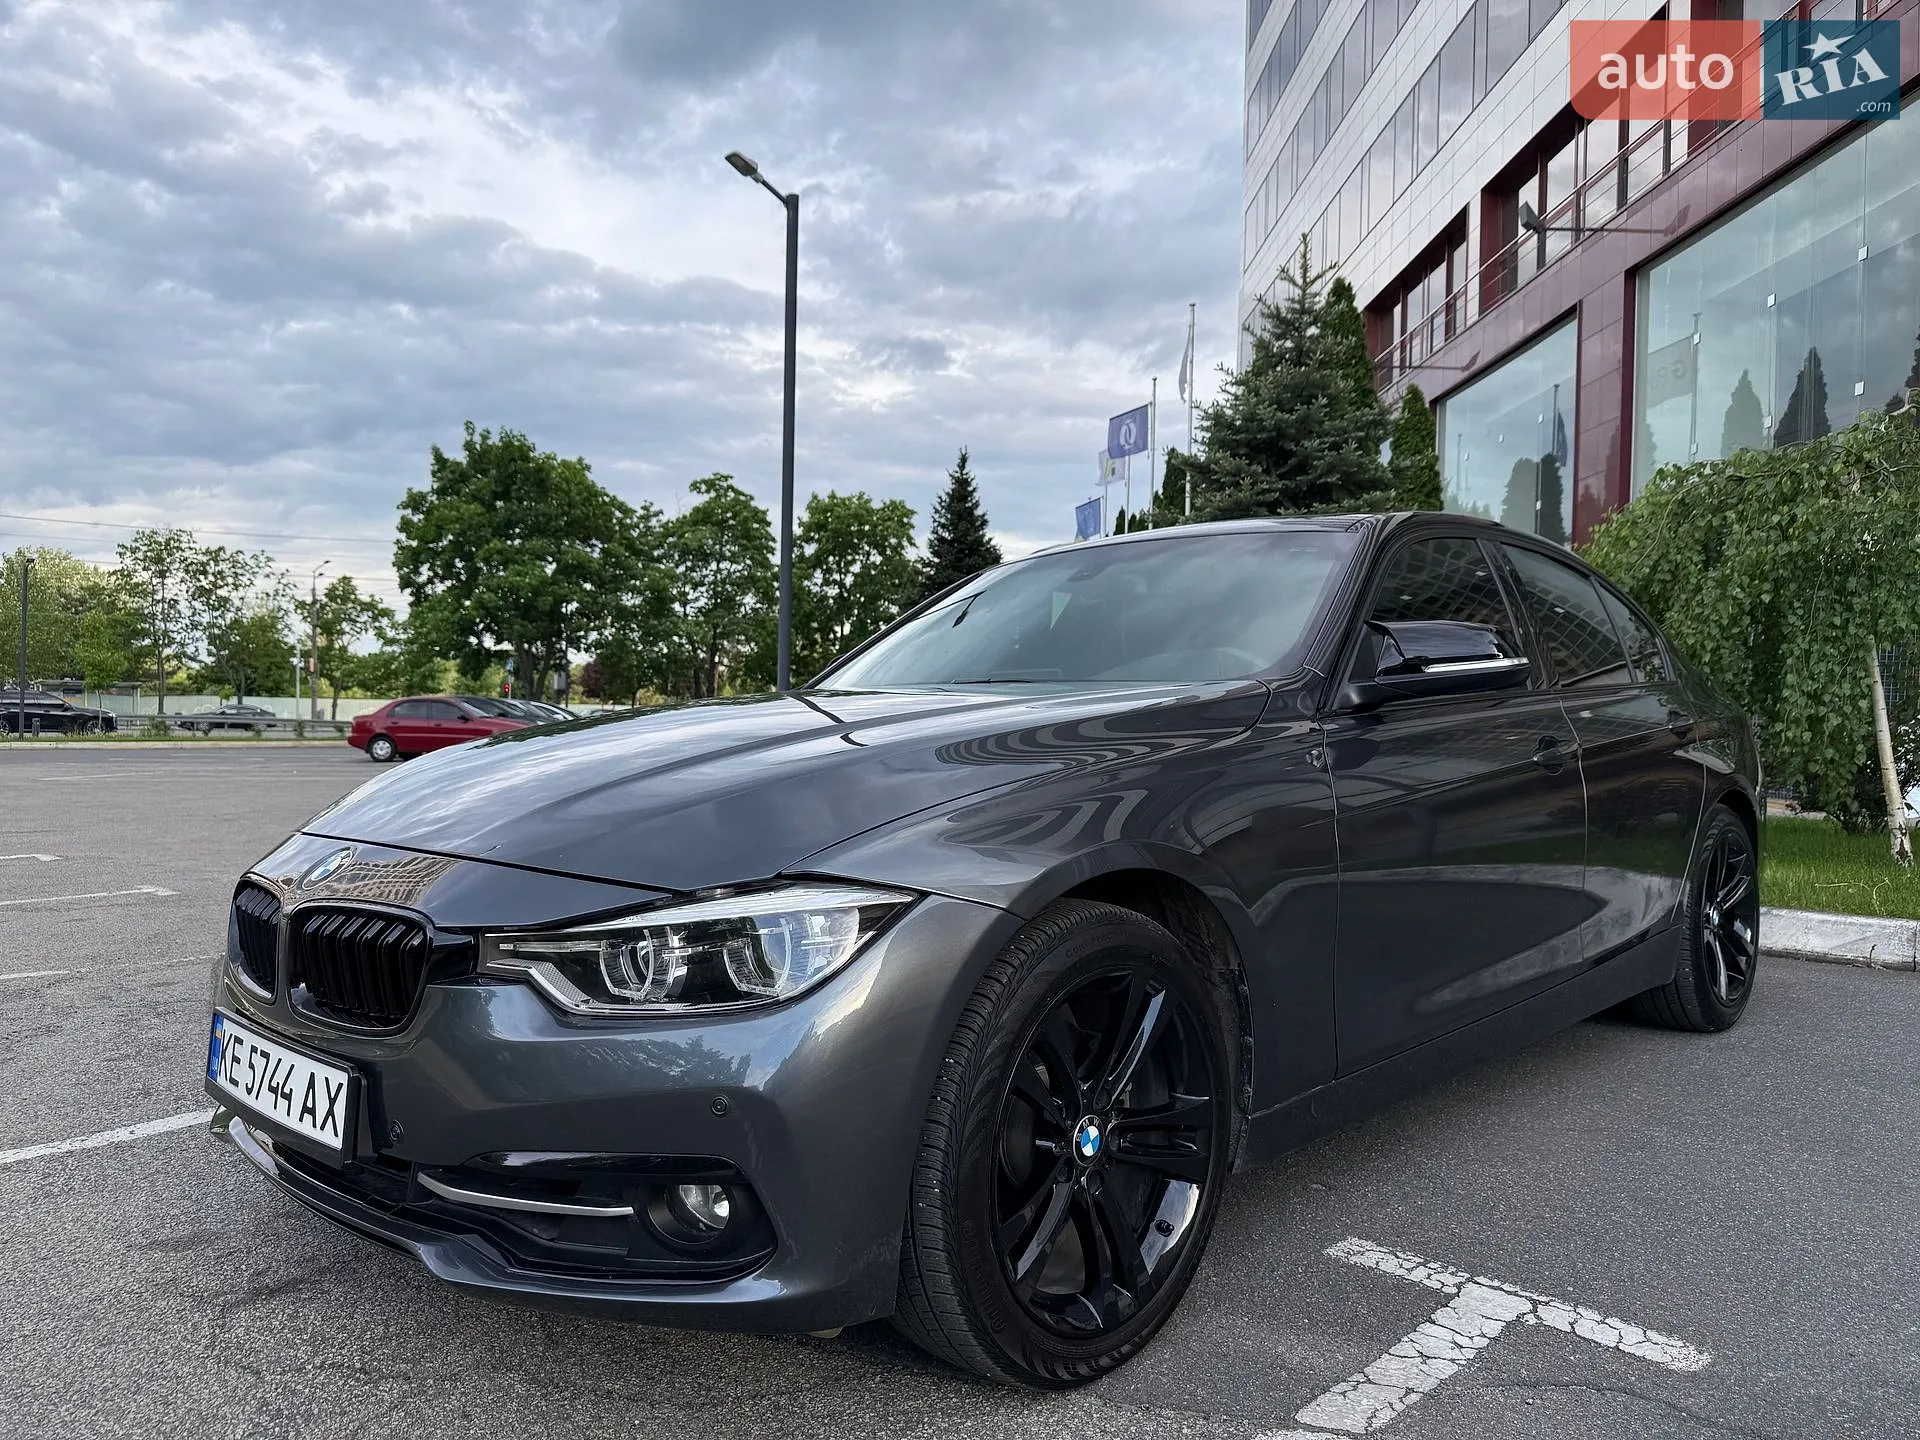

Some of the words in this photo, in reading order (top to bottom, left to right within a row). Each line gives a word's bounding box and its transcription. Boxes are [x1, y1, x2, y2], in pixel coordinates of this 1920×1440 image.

[219, 1029, 244, 1088] KE
[245, 1044, 295, 1117] 5744
[299, 1072, 343, 1137] AX
